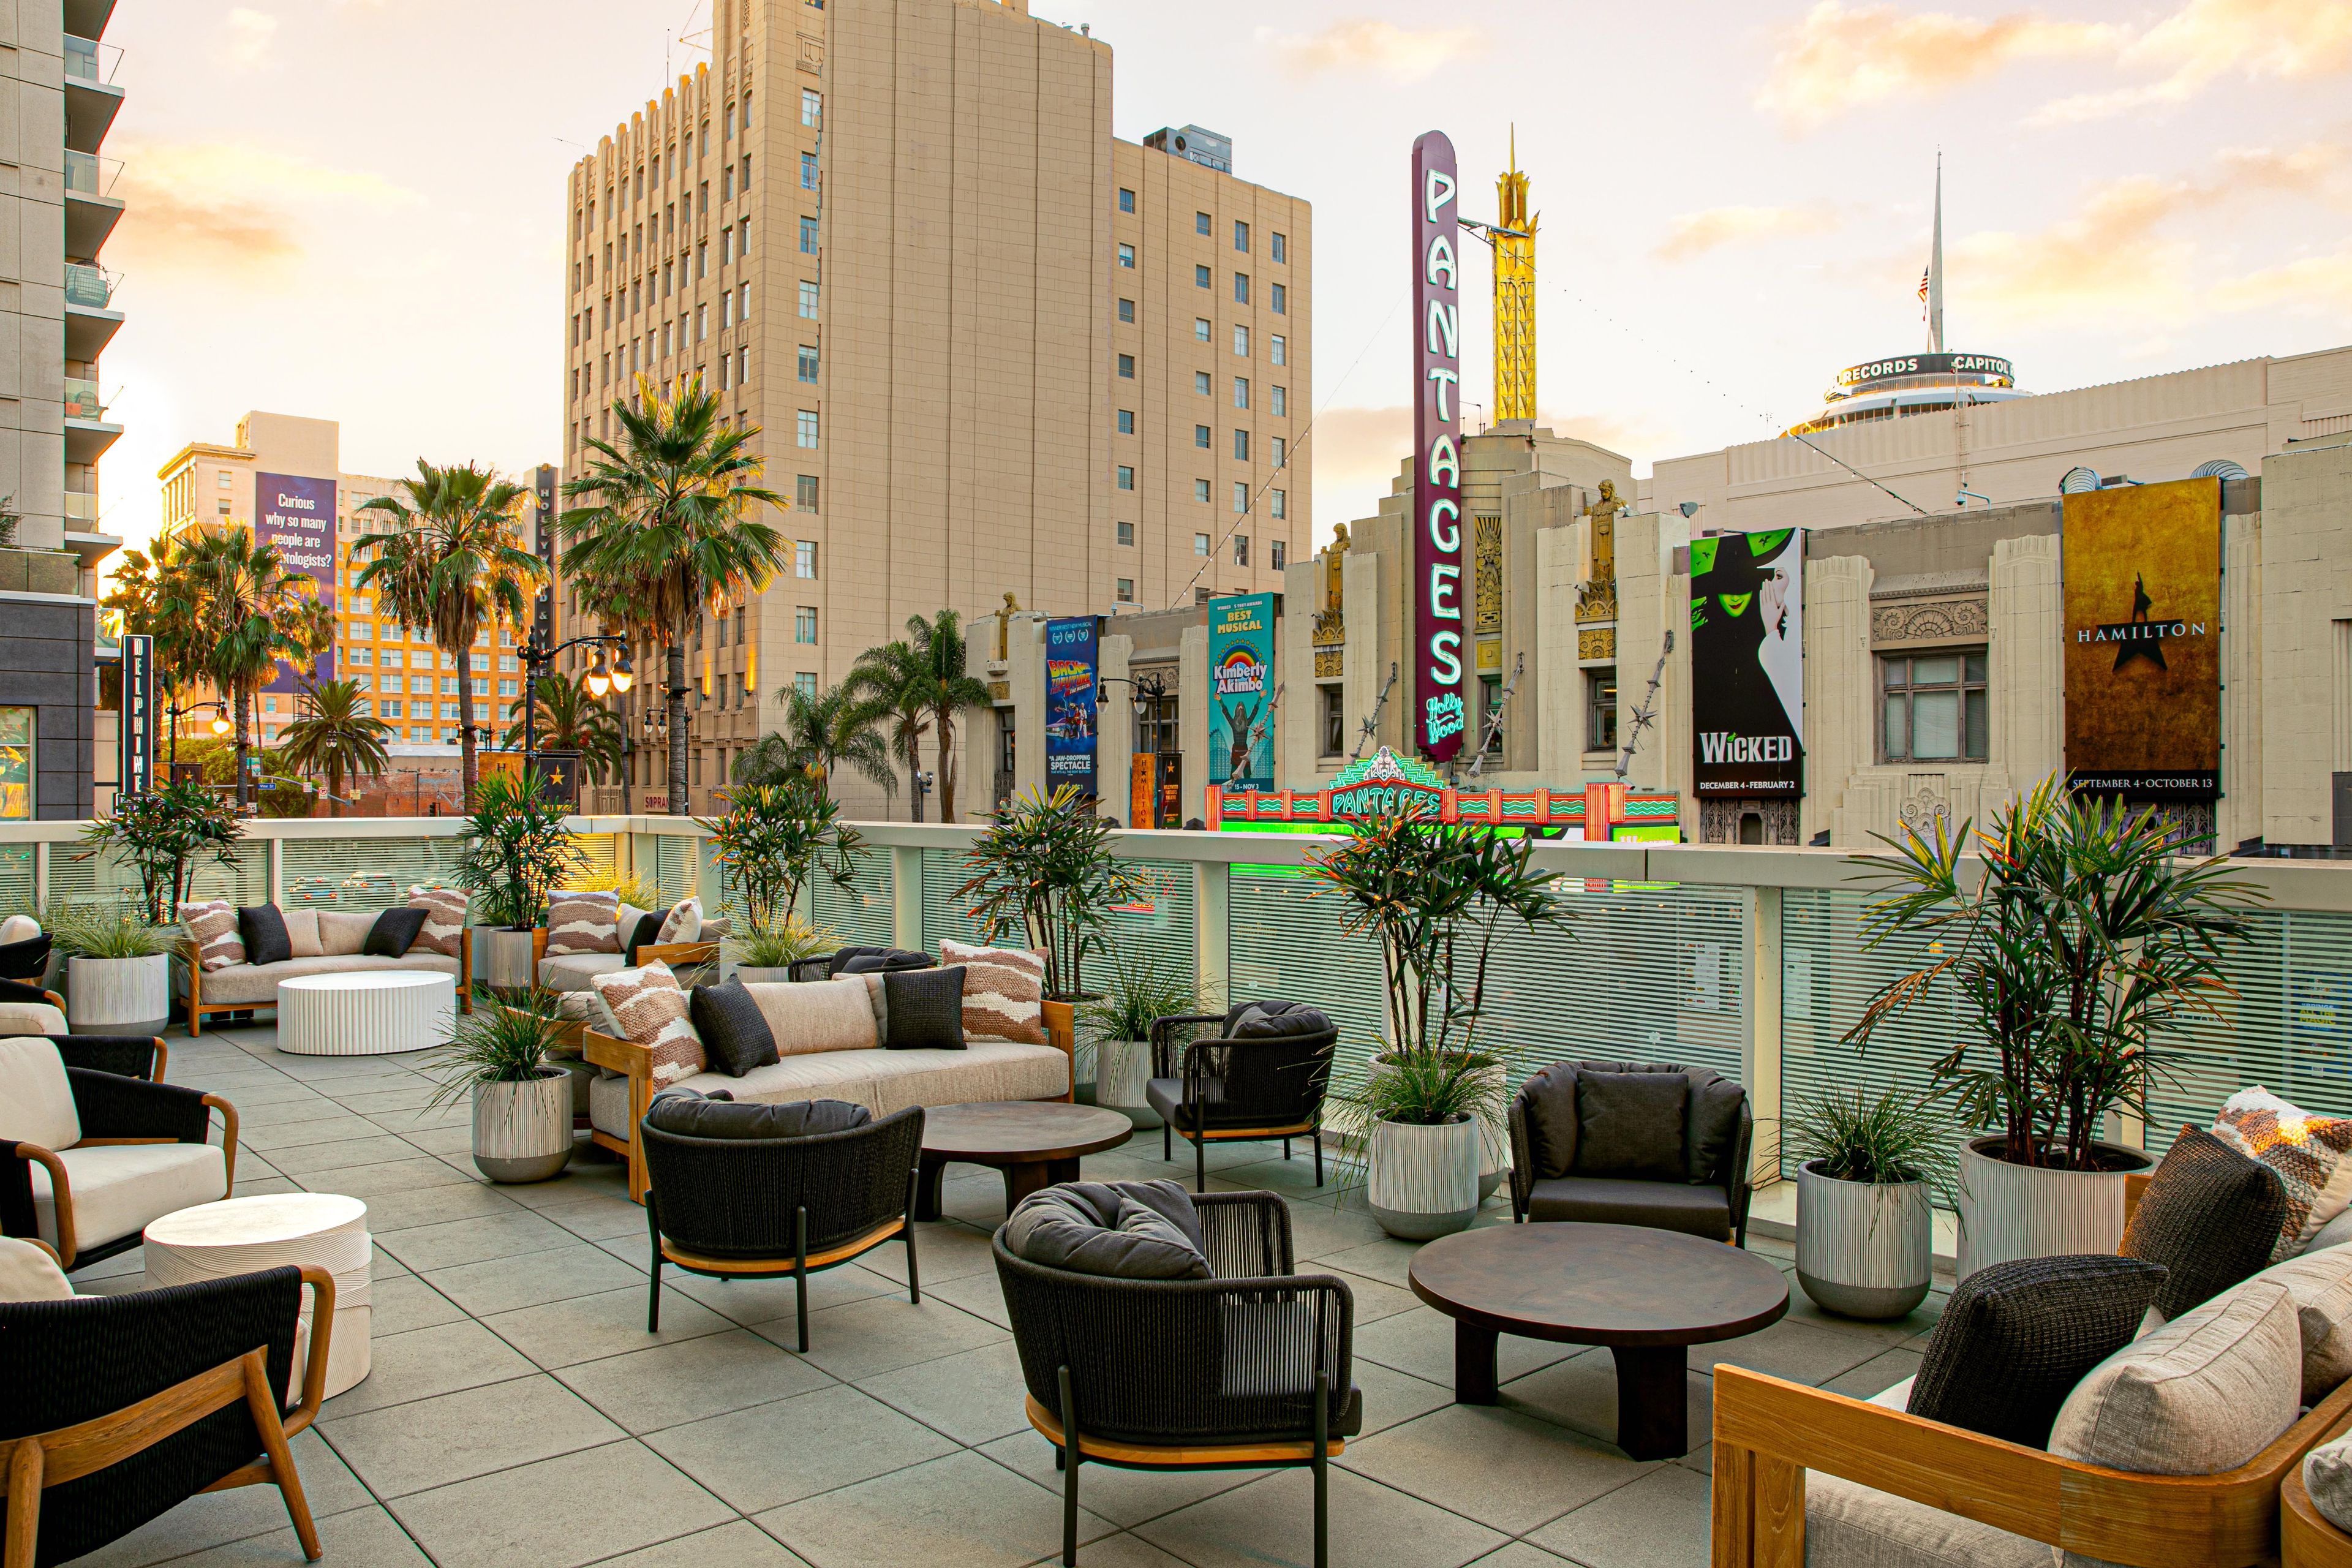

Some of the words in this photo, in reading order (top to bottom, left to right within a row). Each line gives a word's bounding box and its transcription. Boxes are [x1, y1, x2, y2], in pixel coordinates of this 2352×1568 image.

[1843, 358, 1918, 383] RECORDS
[1954, 356, 2010, 375] CAPITOL
[1427, 168, 1461, 685] PANTAGES
[277, 493, 315, 510] Curious
[265, 511, 286, 529] why
[287, 516, 299, 527] so
[300, 518, 327, 533] many
[271, 532, 303, 549] people
[304, 537, 321, 548] are
[540, 489, 550, 602] HOLLYWD
[1227, 609, 1252, 622] BEST
[1217, 620, 1263, 635] MUSICAL
[2078, 622, 2205, 643] HAMILTON
[1047, 660, 1091, 677] BACK
[1213, 662, 1268, 680] Kimberly
[1216, 676, 1263, 693] Akimbo
[133, 638, 143, 793] DELPHINE
[1426, 692, 1463, 721] Holly
[1426, 712, 1464, 745] Wood
[1050, 761, 1091, 770] SPECTACLE
[2073, 779, 2132, 788] SEPTEMBER
[2133, 779, 2140, 788] 4
[2146, 779, 2200, 788] OCTOBER
[2203, 779, 2212, 788] 13
